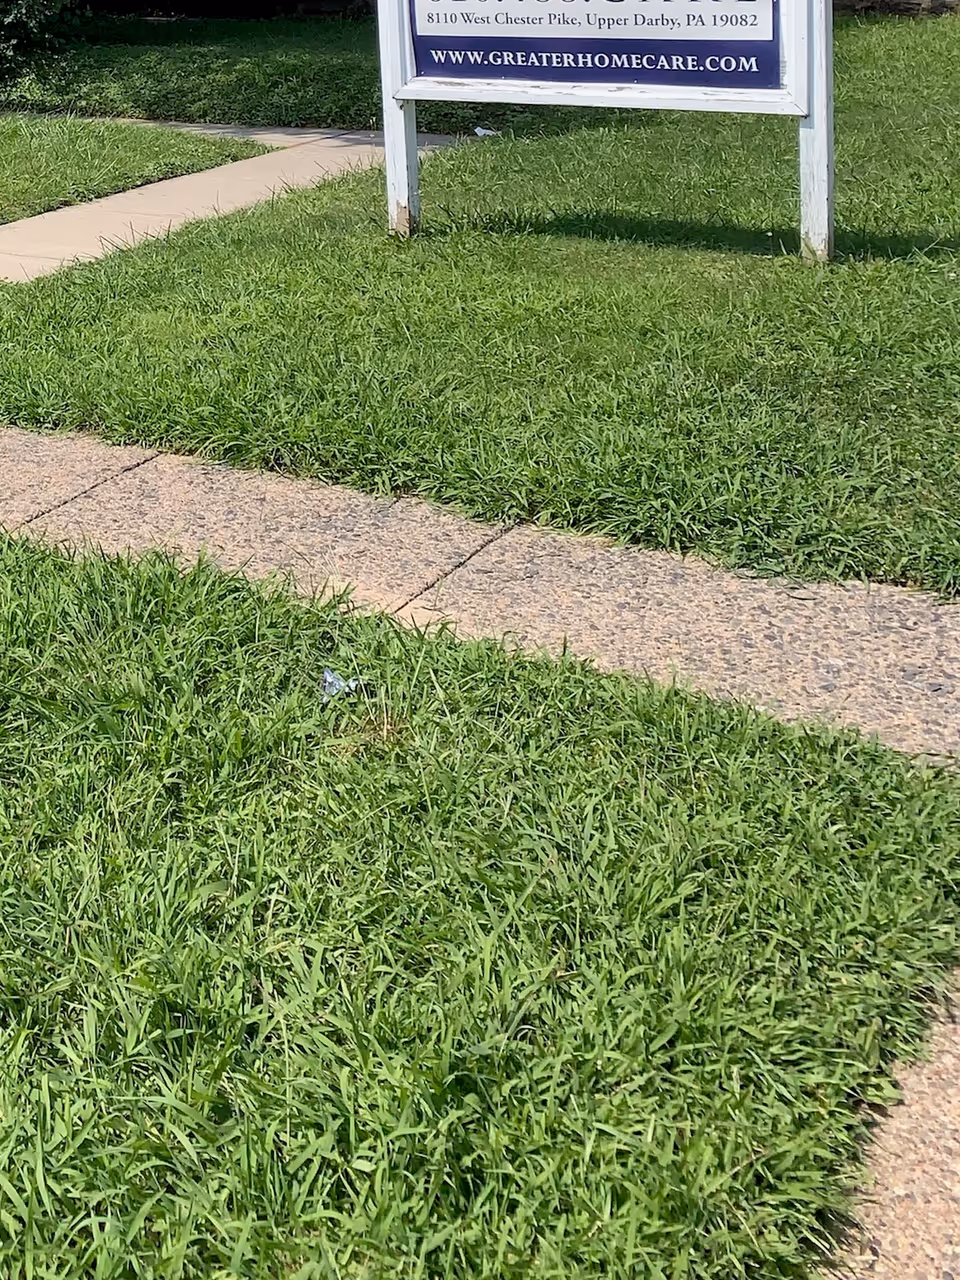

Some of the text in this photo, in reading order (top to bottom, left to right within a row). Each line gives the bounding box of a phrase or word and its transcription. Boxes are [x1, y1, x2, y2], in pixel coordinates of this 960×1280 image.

[426, 12, 759, 31] 8110 West Chester Pike, Upper Darby, PA 19082
[429, 49, 760, 72] WWW.GREATERHOMECARE.COM
